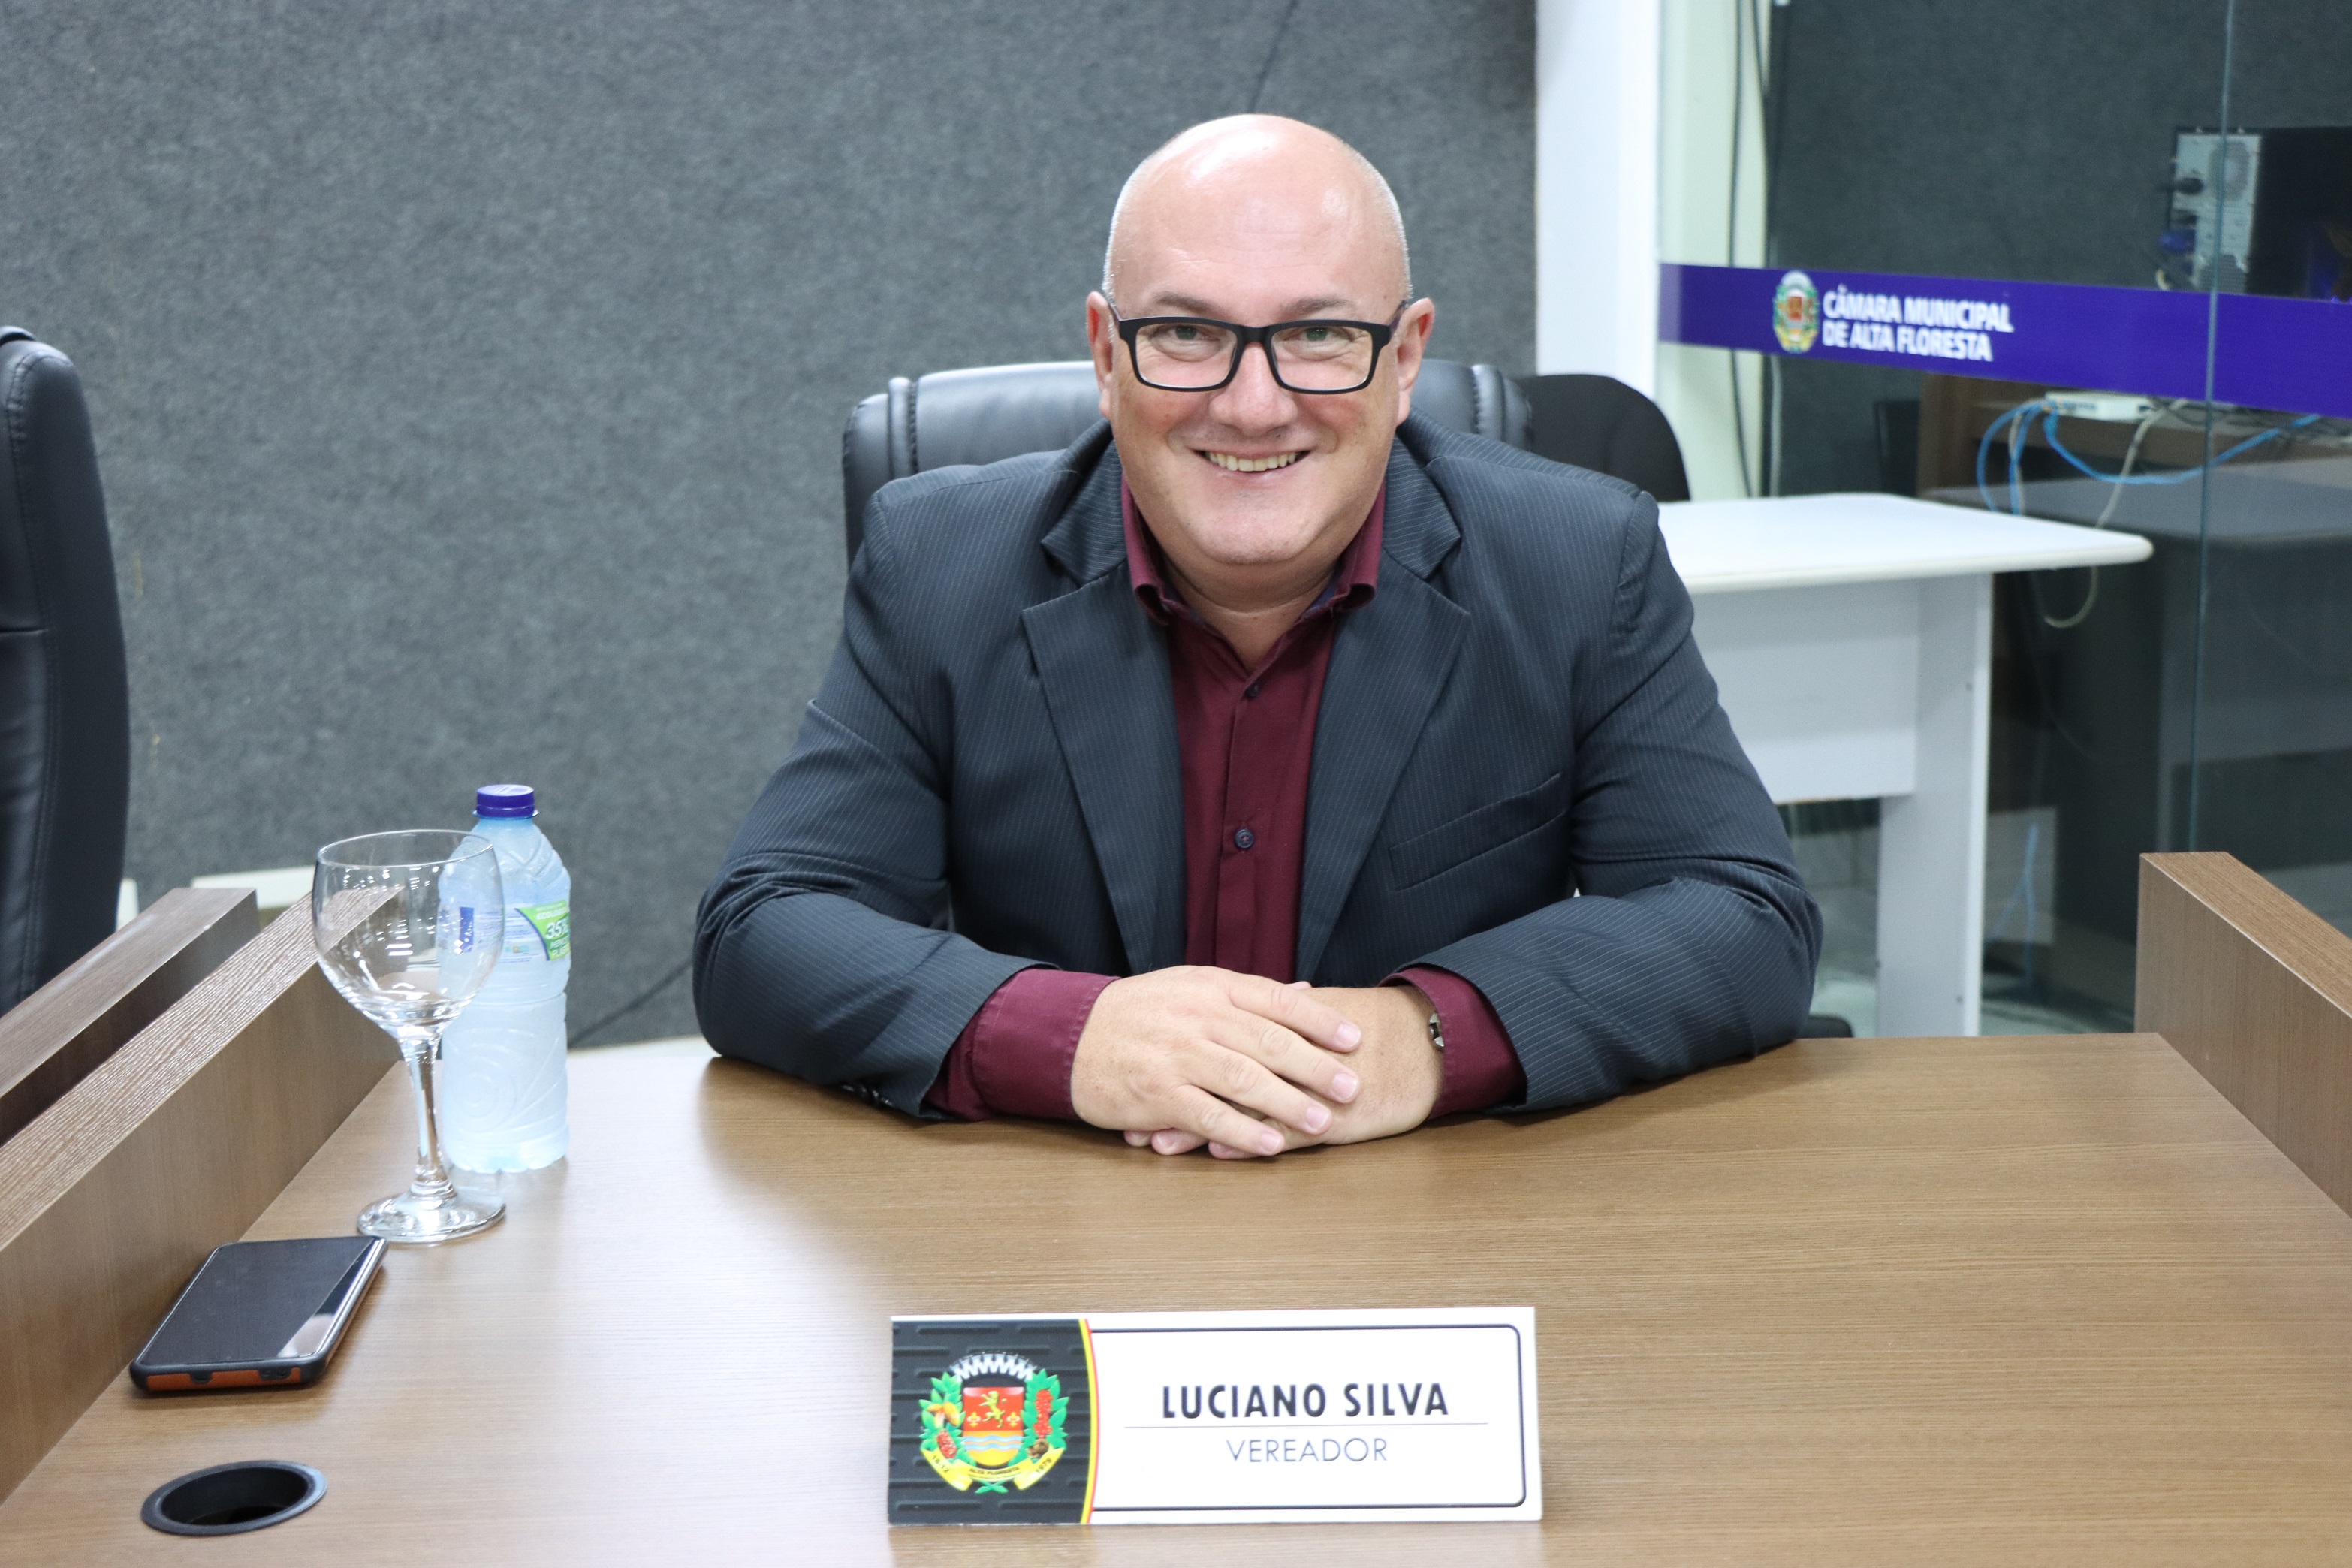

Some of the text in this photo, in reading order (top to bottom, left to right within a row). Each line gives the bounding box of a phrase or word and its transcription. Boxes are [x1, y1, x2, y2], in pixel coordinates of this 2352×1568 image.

[1823, 283, 2014, 333] CÂMARA MUNICIPAL
[1823, 319, 1994, 362] DE ALTA FLORESTA
[1162, 1382, 1449, 1419] LUCIANO SILVA
[1226, 1437, 1388, 1463] VEREADOR
